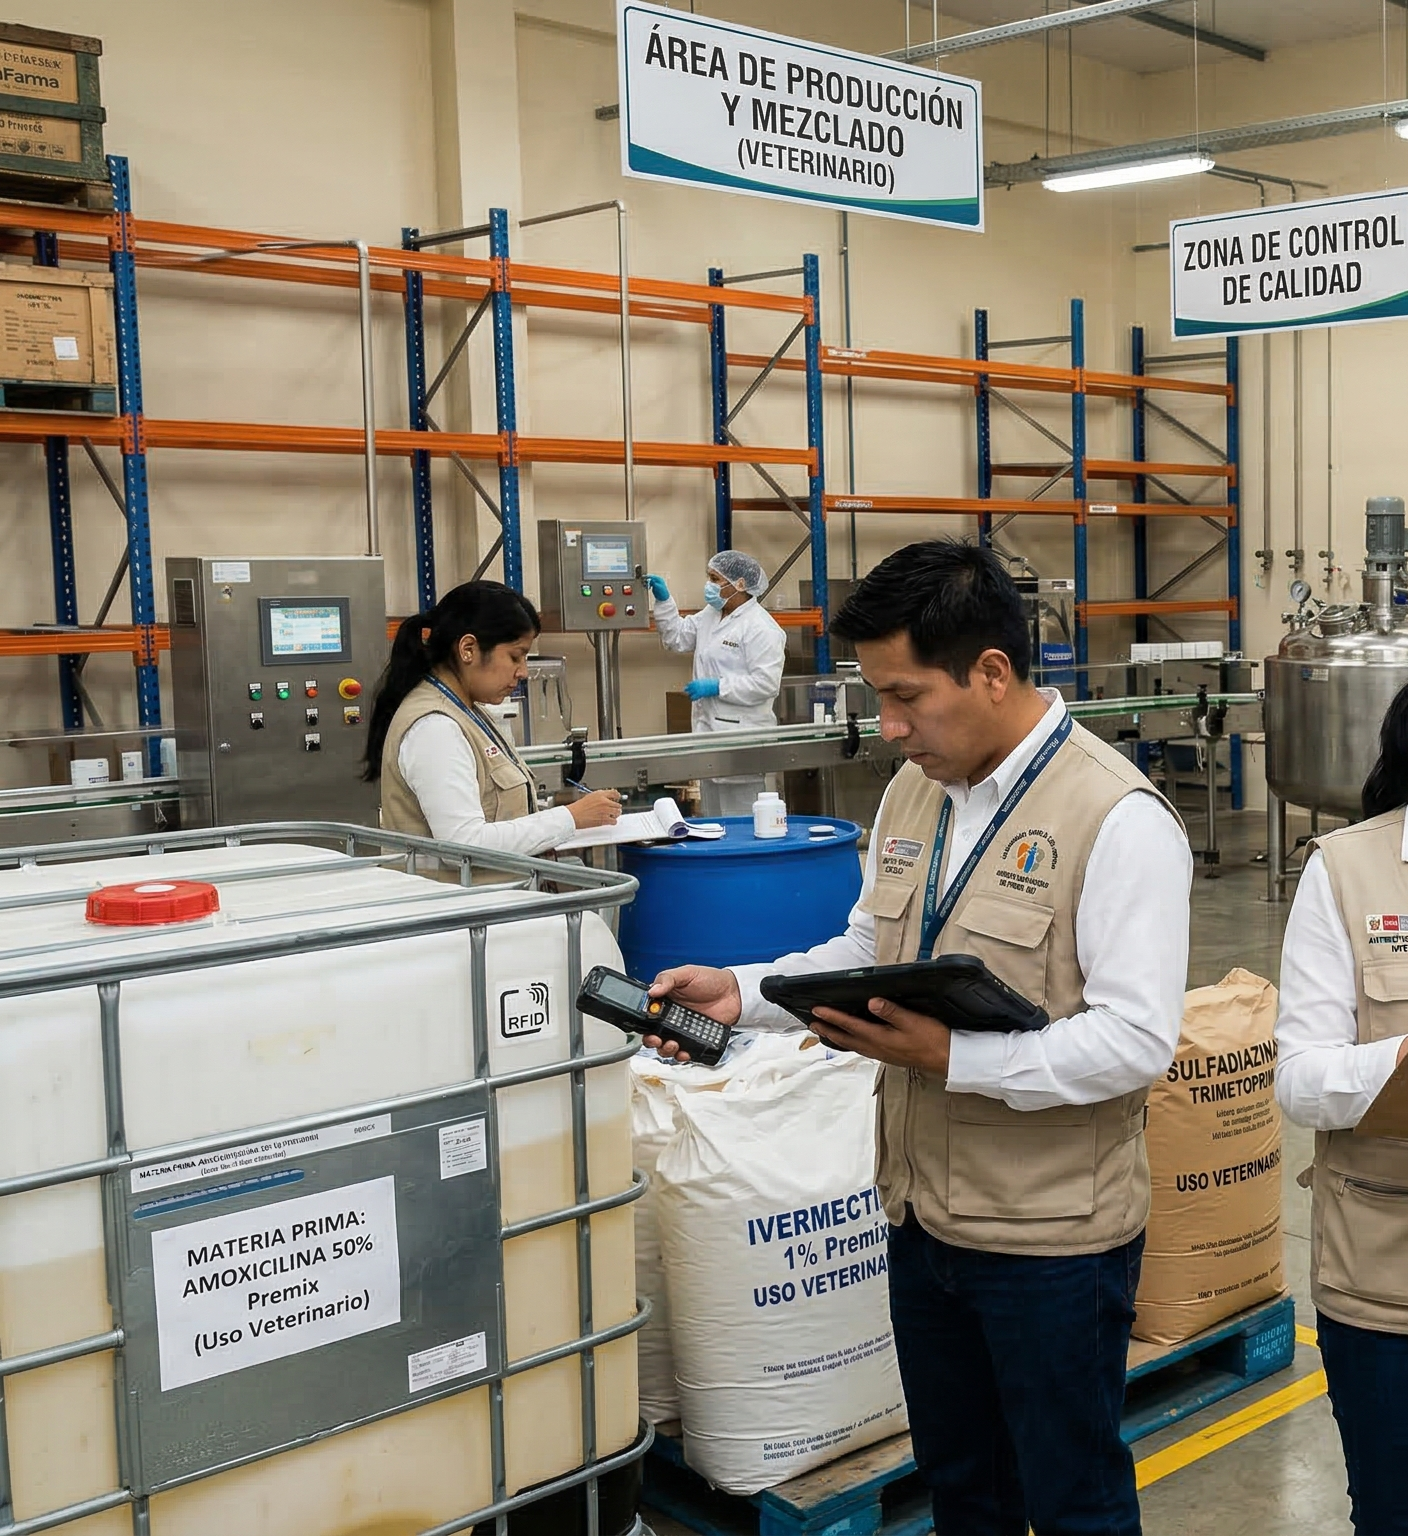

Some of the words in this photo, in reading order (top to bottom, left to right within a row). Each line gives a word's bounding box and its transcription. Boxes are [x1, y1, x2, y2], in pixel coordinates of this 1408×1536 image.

[645, 23, 728, 81] ÁREA
[739, 51, 776, 91] DE
[787, 62, 963, 130] PRODUCCIÓN
[721, 92, 741, 126] Y
[752, 98, 904, 157] MEZCLADO
[738, 138, 895, 194] (VETERINARIO)
[1183, 236, 1244, 272] ZONA
[1252, 231, 1281, 262] DE
[1289, 215, 1404, 258] CONTROL
[1223, 275, 1251, 305] DE
[1259, 262, 1362, 302] CALIDAD
[508, 1012, 545, 1030] RFID
[1176, 1172, 1209, 1192] USO
[187, 1228, 286, 1267] MATERIA
[292, 1210, 366, 1241] PRIMA:
[748, 1185, 883, 1246] IVERMECTI
[182, 1247, 326, 1298] AMOXICILINA
[332, 1234, 373, 1260] 50%
[784, 1241, 818, 1270] 1%
[825, 1221, 888, 1260] Premix
[248, 1278, 319, 1310] Premix
[754, 1282, 796, 1308] USO
[801, 1252, 889, 1297] VETERINA
[194, 1328, 242, 1357] (Uso
[249, 1289, 370, 1338] Veterinario)
